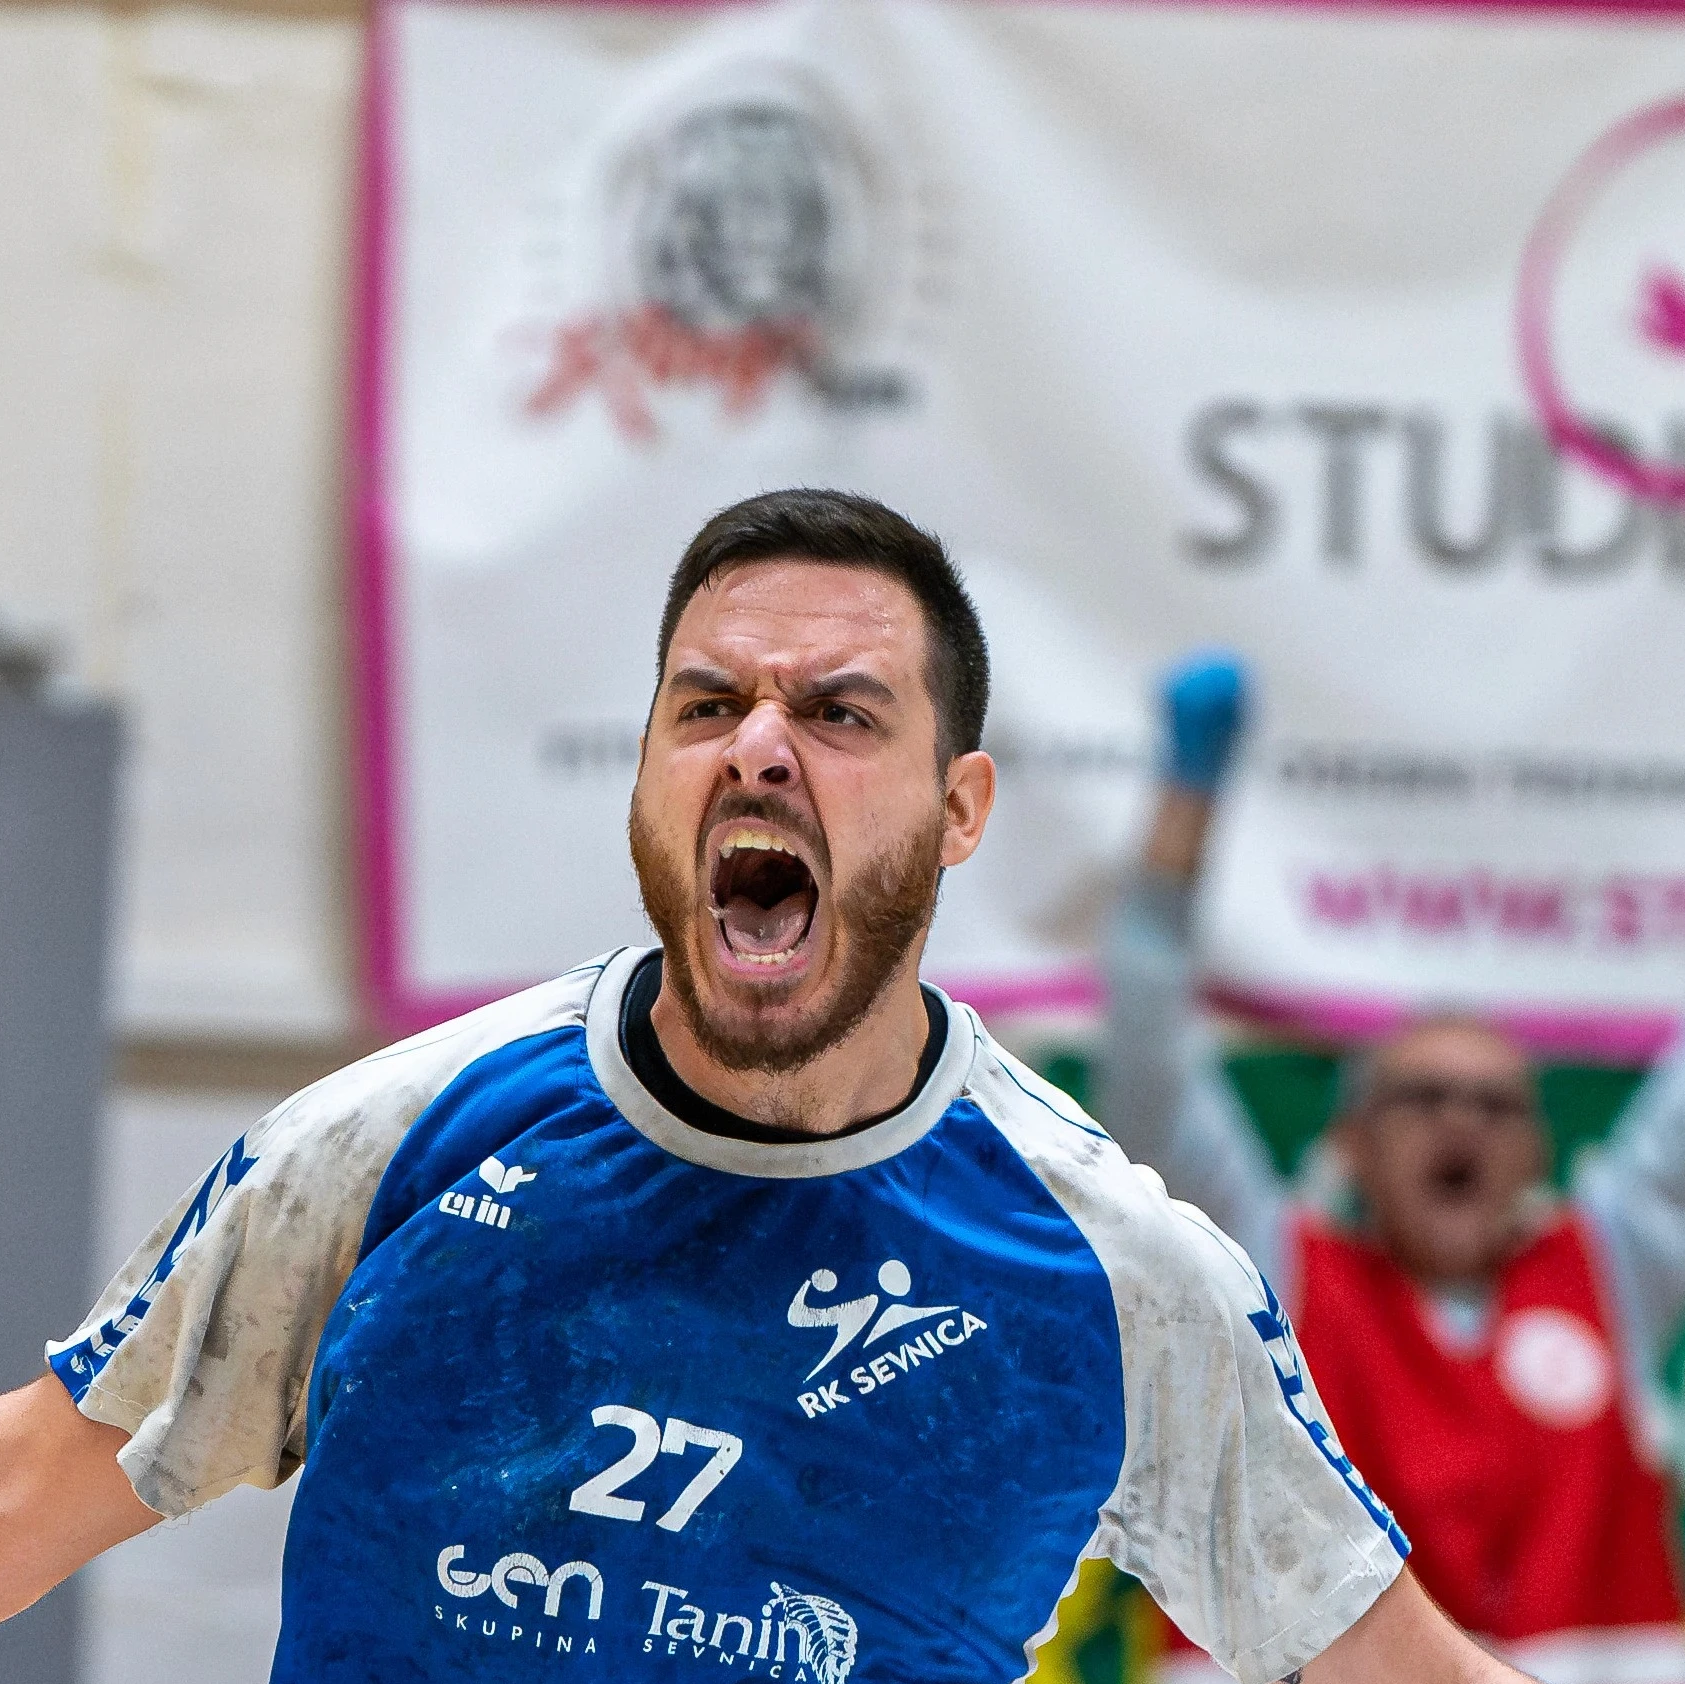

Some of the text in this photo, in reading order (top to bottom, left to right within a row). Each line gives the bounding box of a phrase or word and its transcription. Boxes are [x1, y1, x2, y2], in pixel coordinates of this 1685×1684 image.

[796, 1310, 988, 1419] RK SEVNICA
[568, 1404, 744, 1533] 27
[434, 1604, 597, 1654] SKUPINA
[641, 1580, 810, 1664] Tanin
[643, 1637, 807, 1683] SEVNICA
